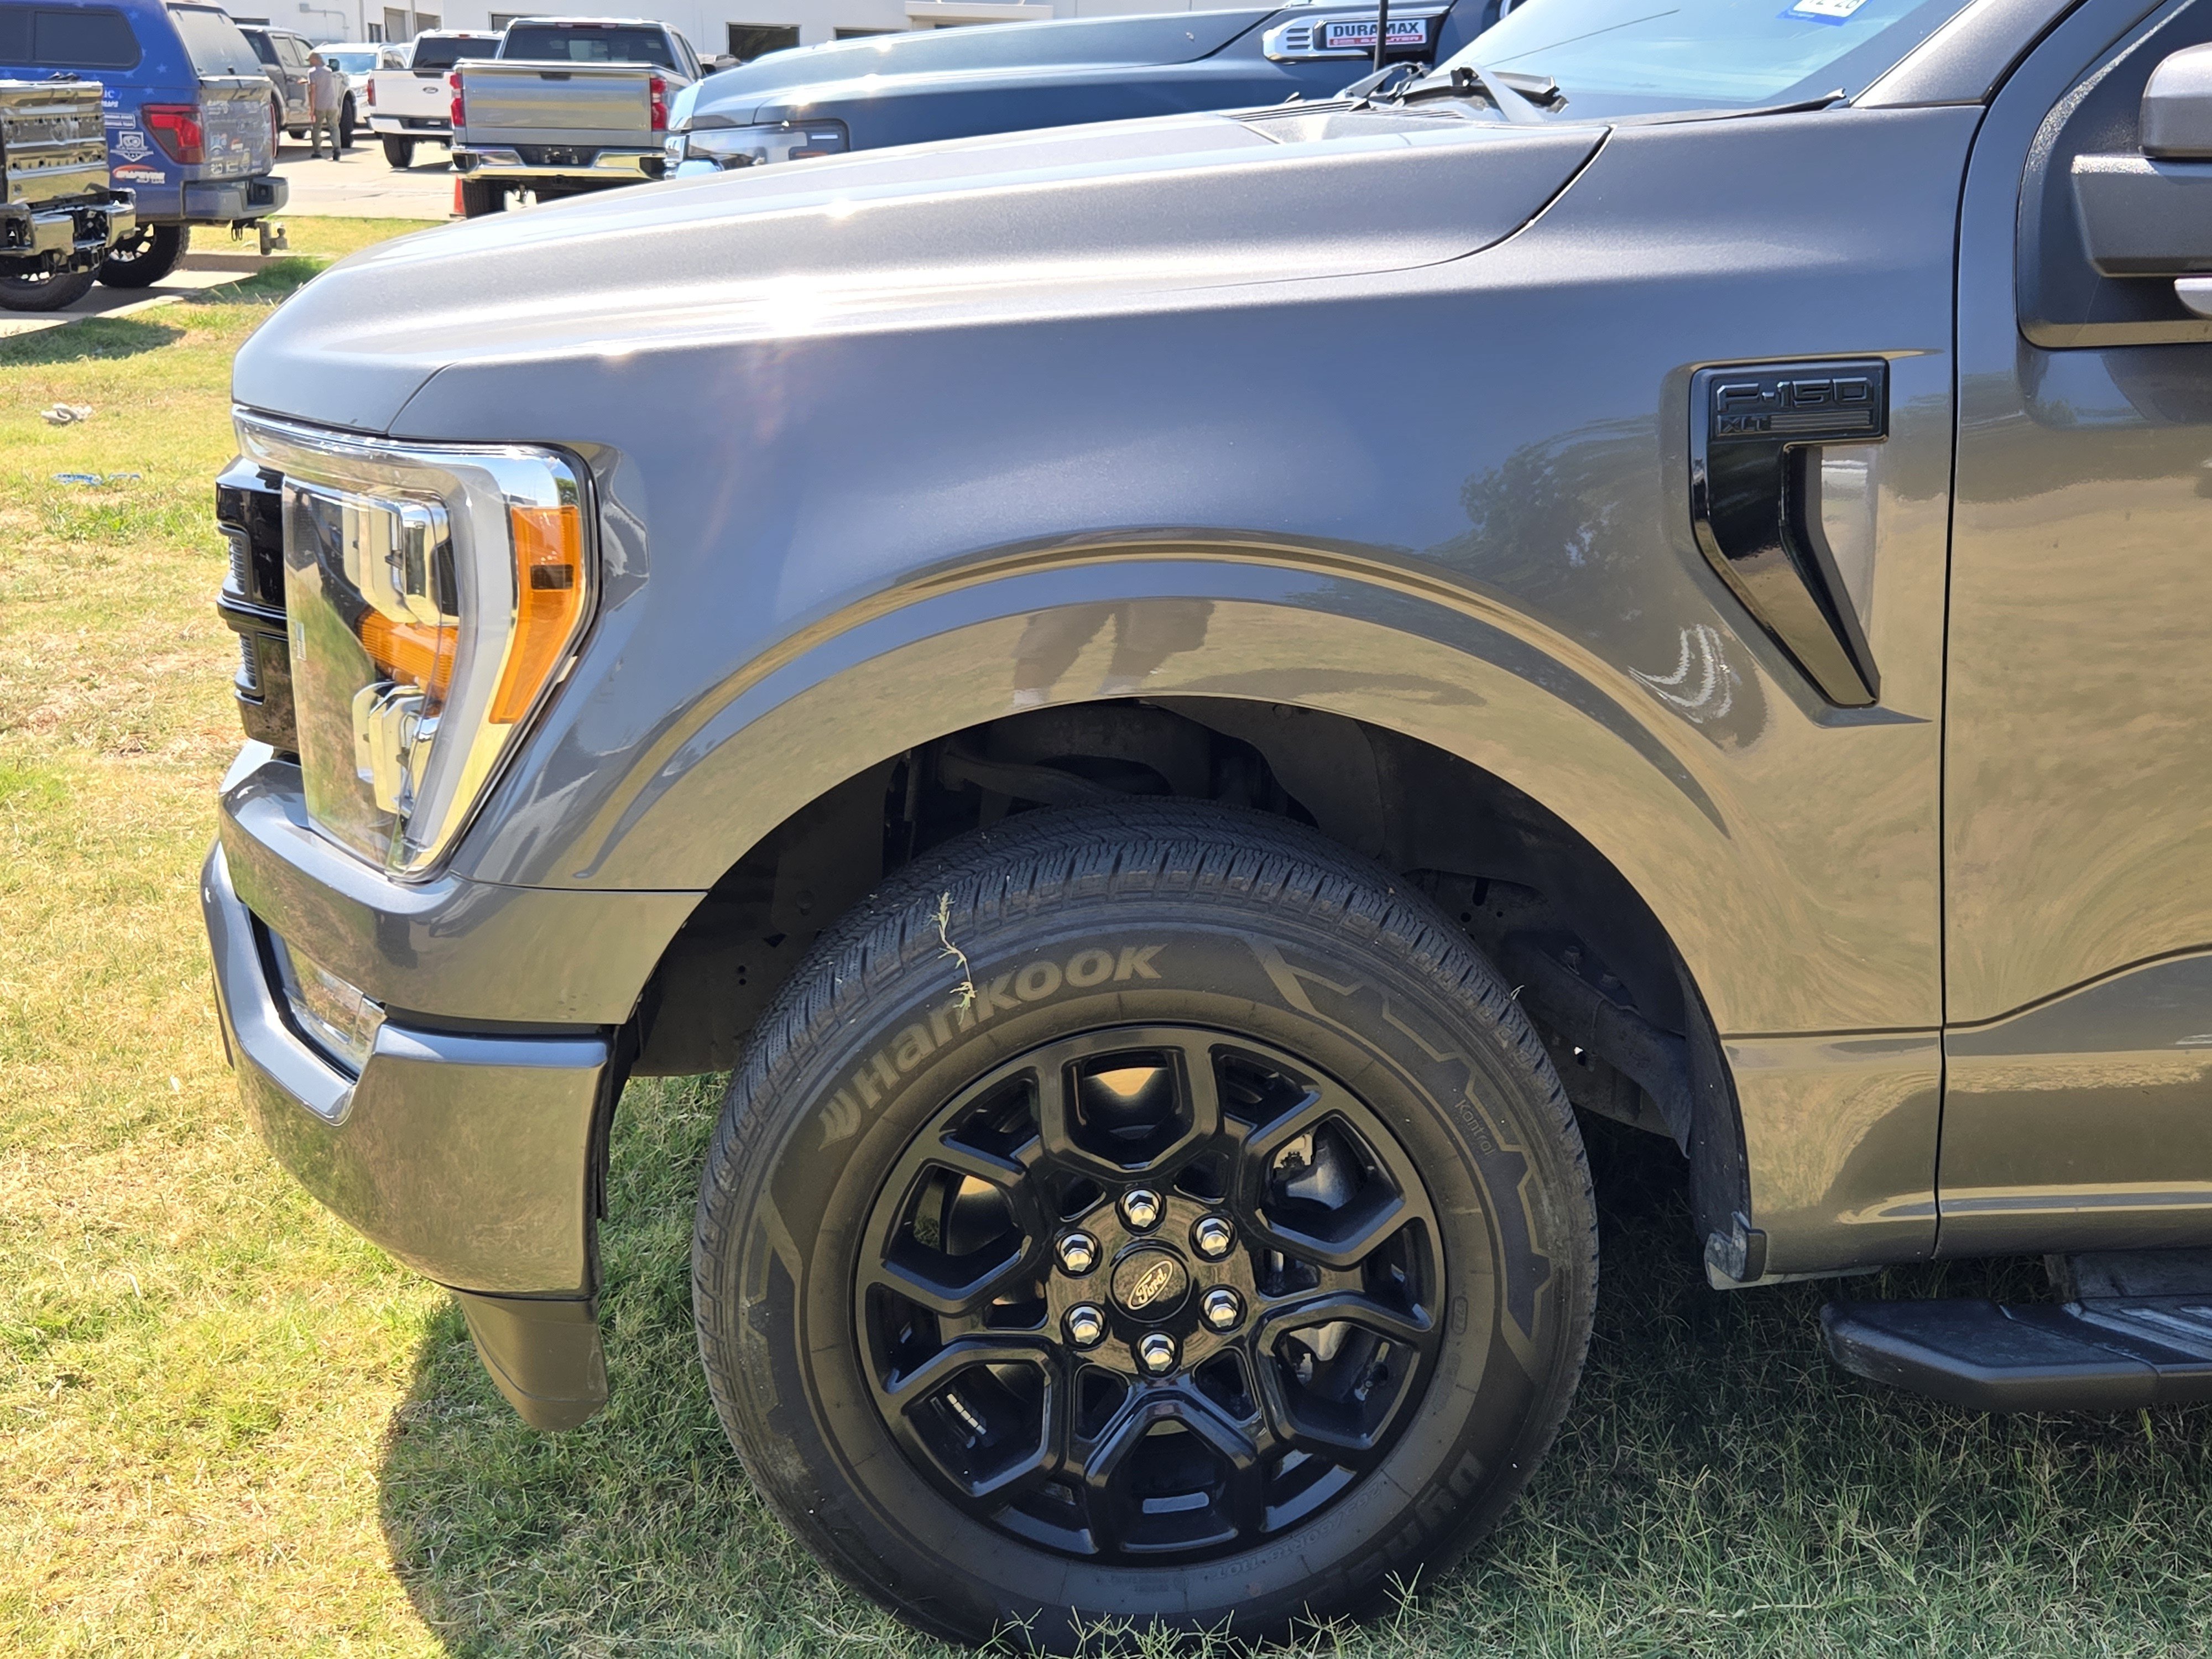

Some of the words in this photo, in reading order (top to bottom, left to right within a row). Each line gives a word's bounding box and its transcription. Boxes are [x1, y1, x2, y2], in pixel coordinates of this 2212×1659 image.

[1333, 22, 1419, 37] DURAMAX
[1717, 377, 1873, 413] F-150
[1721, 417, 1768, 433] XLT
[1136, 1267, 1167, 1303] Ford
